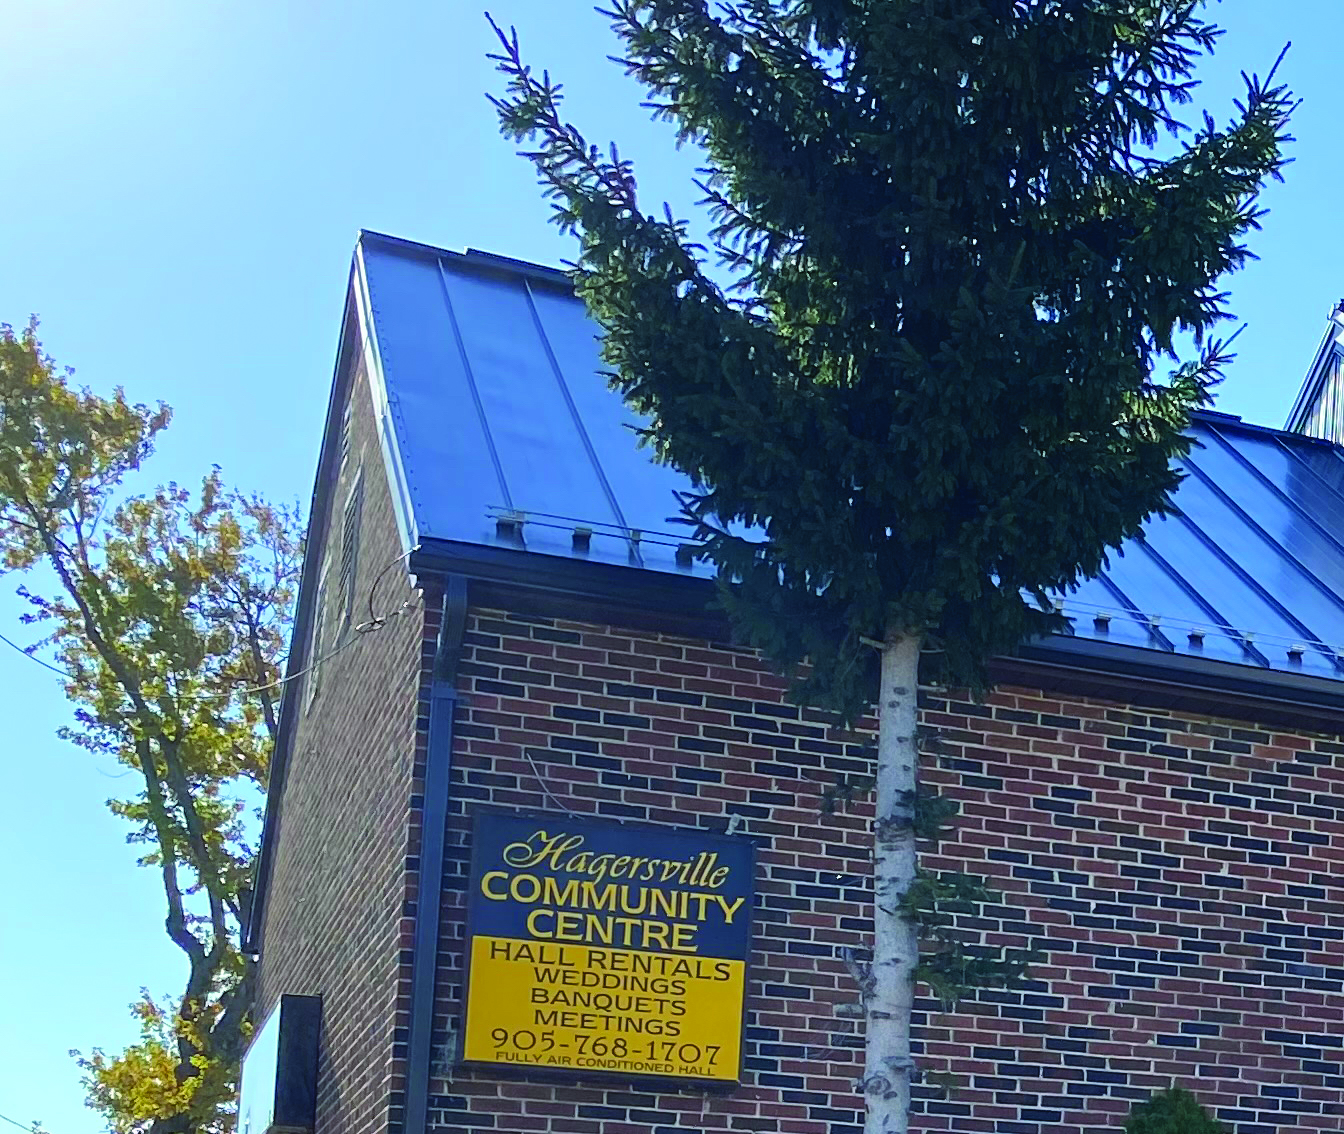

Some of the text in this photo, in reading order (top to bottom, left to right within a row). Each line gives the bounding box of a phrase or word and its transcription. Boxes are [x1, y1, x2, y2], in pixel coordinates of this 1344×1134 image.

[503, 830, 730, 888] Hagersville
[481, 871, 745, 924] COMMUNITY
[526, 908, 698, 952] CENTRE
[490, 940, 731, 982] HALL RENTALS
[534, 966, 687, 996] WEDDINGS
[531, 987, 687, 1016] BANQUETS
[534, 1009, 681, 1037] MEETINGS
[491, 1028, 721, 1065] 905-768-1707
[495, 1051, 716, 1077] FULLY AIR CONDITIONED HALL
